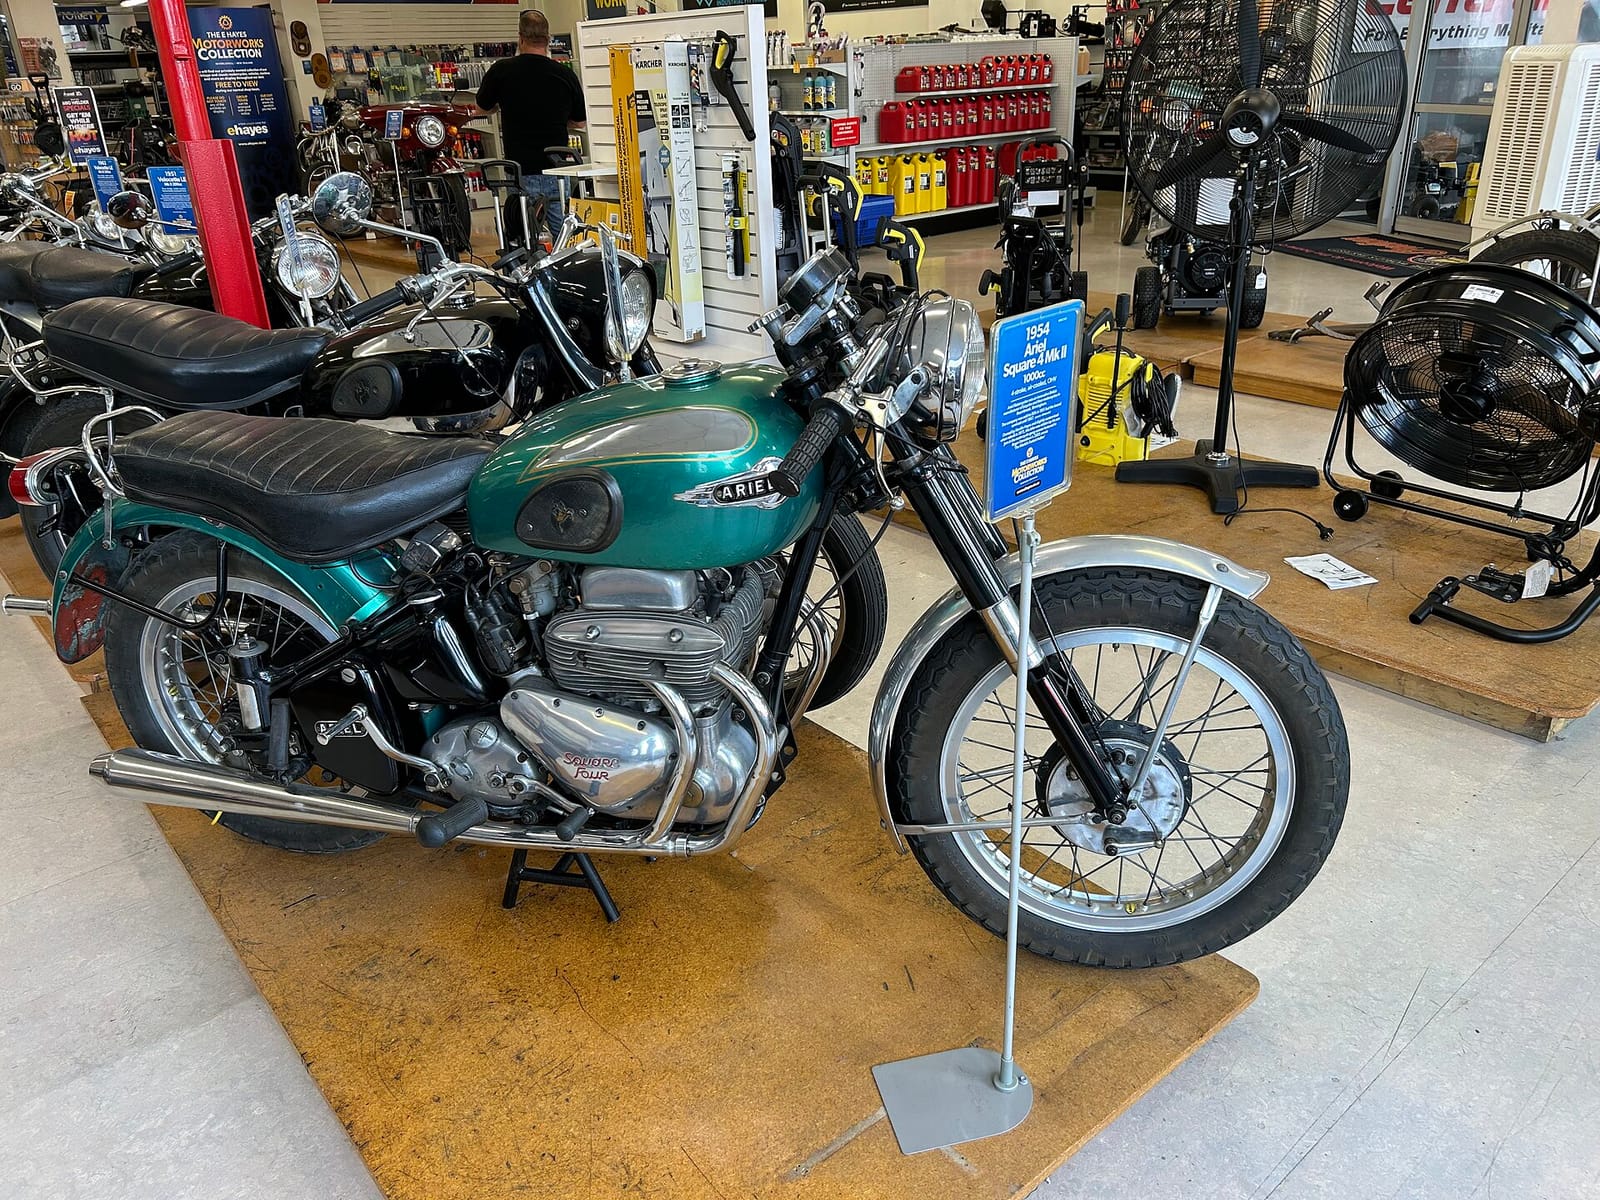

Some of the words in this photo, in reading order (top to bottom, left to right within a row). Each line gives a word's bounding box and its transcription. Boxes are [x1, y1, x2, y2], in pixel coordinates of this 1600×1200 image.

[221, 31, 226, 39] E
[1400, 24, 1490, 42] Erything
[192, 38, 264, 49] MOTORWORKS
[198, 48, 262, 60] COLLECTION
[215, 81, 232, 89] FREE
[242, 80, 258, 88] VIEW
[227, 125, 269, 137] ehayes
[618, 98, 626, 156] ACCOUPLEMENTS
[69, 129, 97, 141] HOT
[74, 146, 101, 155] ehayes
[1026, 322, 1050, 340] 1954
[1024, 338, 1047, 357] Ariel
[1003, 356, 1037, 378] Square
[1036, 351, 1045, 366] 4
[1044, 346, 1061, 364] Mk
[1060, 344, 1068, 360] II
[1023, 370, 1046, 384] 1000cc
[722, 478, 774, 499] ARIEL
[320, 723, 362, 734] AEL
